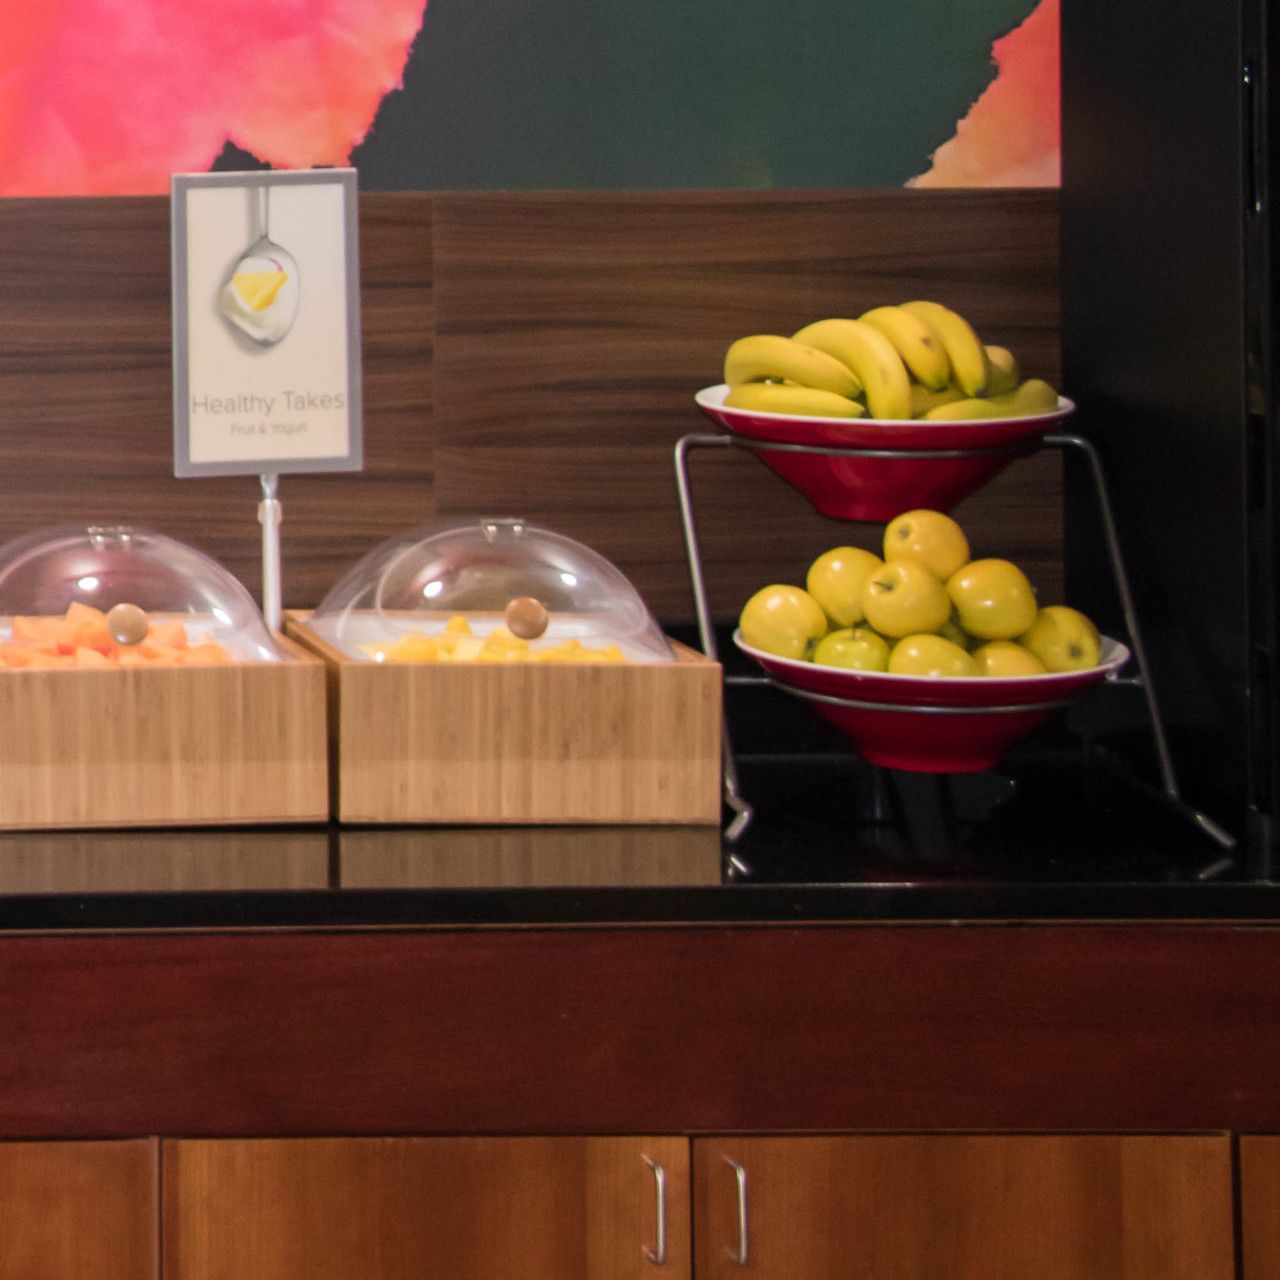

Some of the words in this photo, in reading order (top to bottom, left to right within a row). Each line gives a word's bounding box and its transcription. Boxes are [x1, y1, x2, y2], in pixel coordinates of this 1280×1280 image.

[191, 393, 275, 416] Healthy
[282, 390, 345, 412] Takes
[271, 422, 308, 436] Yogurt
